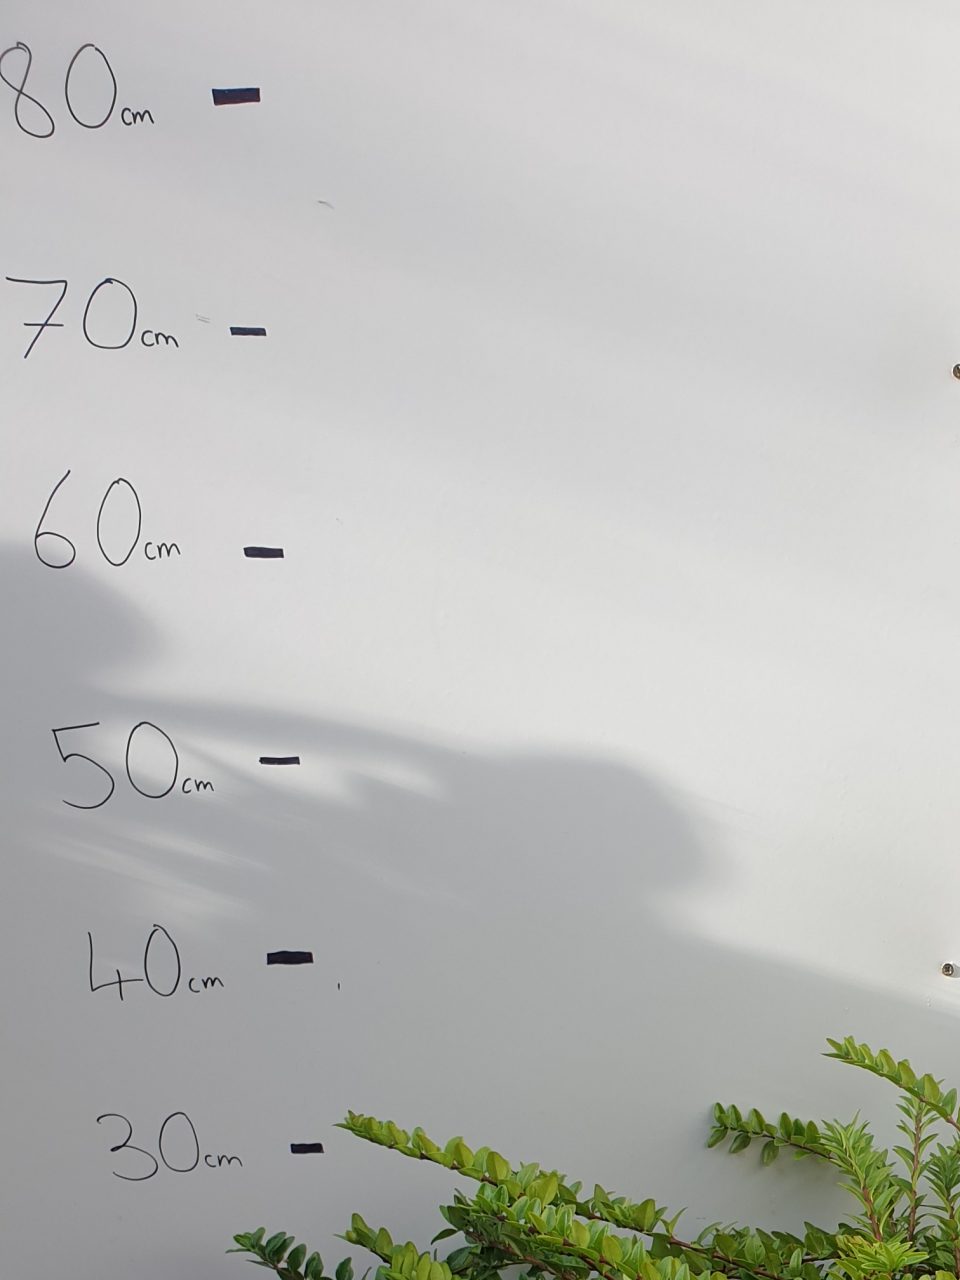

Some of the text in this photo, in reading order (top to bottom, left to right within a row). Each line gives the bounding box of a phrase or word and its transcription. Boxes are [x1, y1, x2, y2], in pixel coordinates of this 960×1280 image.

[0, 41, 155, 138] 80cm
[5, 277, 179, 359] 70cm
[34, 469, 181, 569] 60cm
[51, 721, 215, 810] 50cm
[87, 924, 225, 1001] 40cm
[96, 1111, 243, 1181] 30cm
